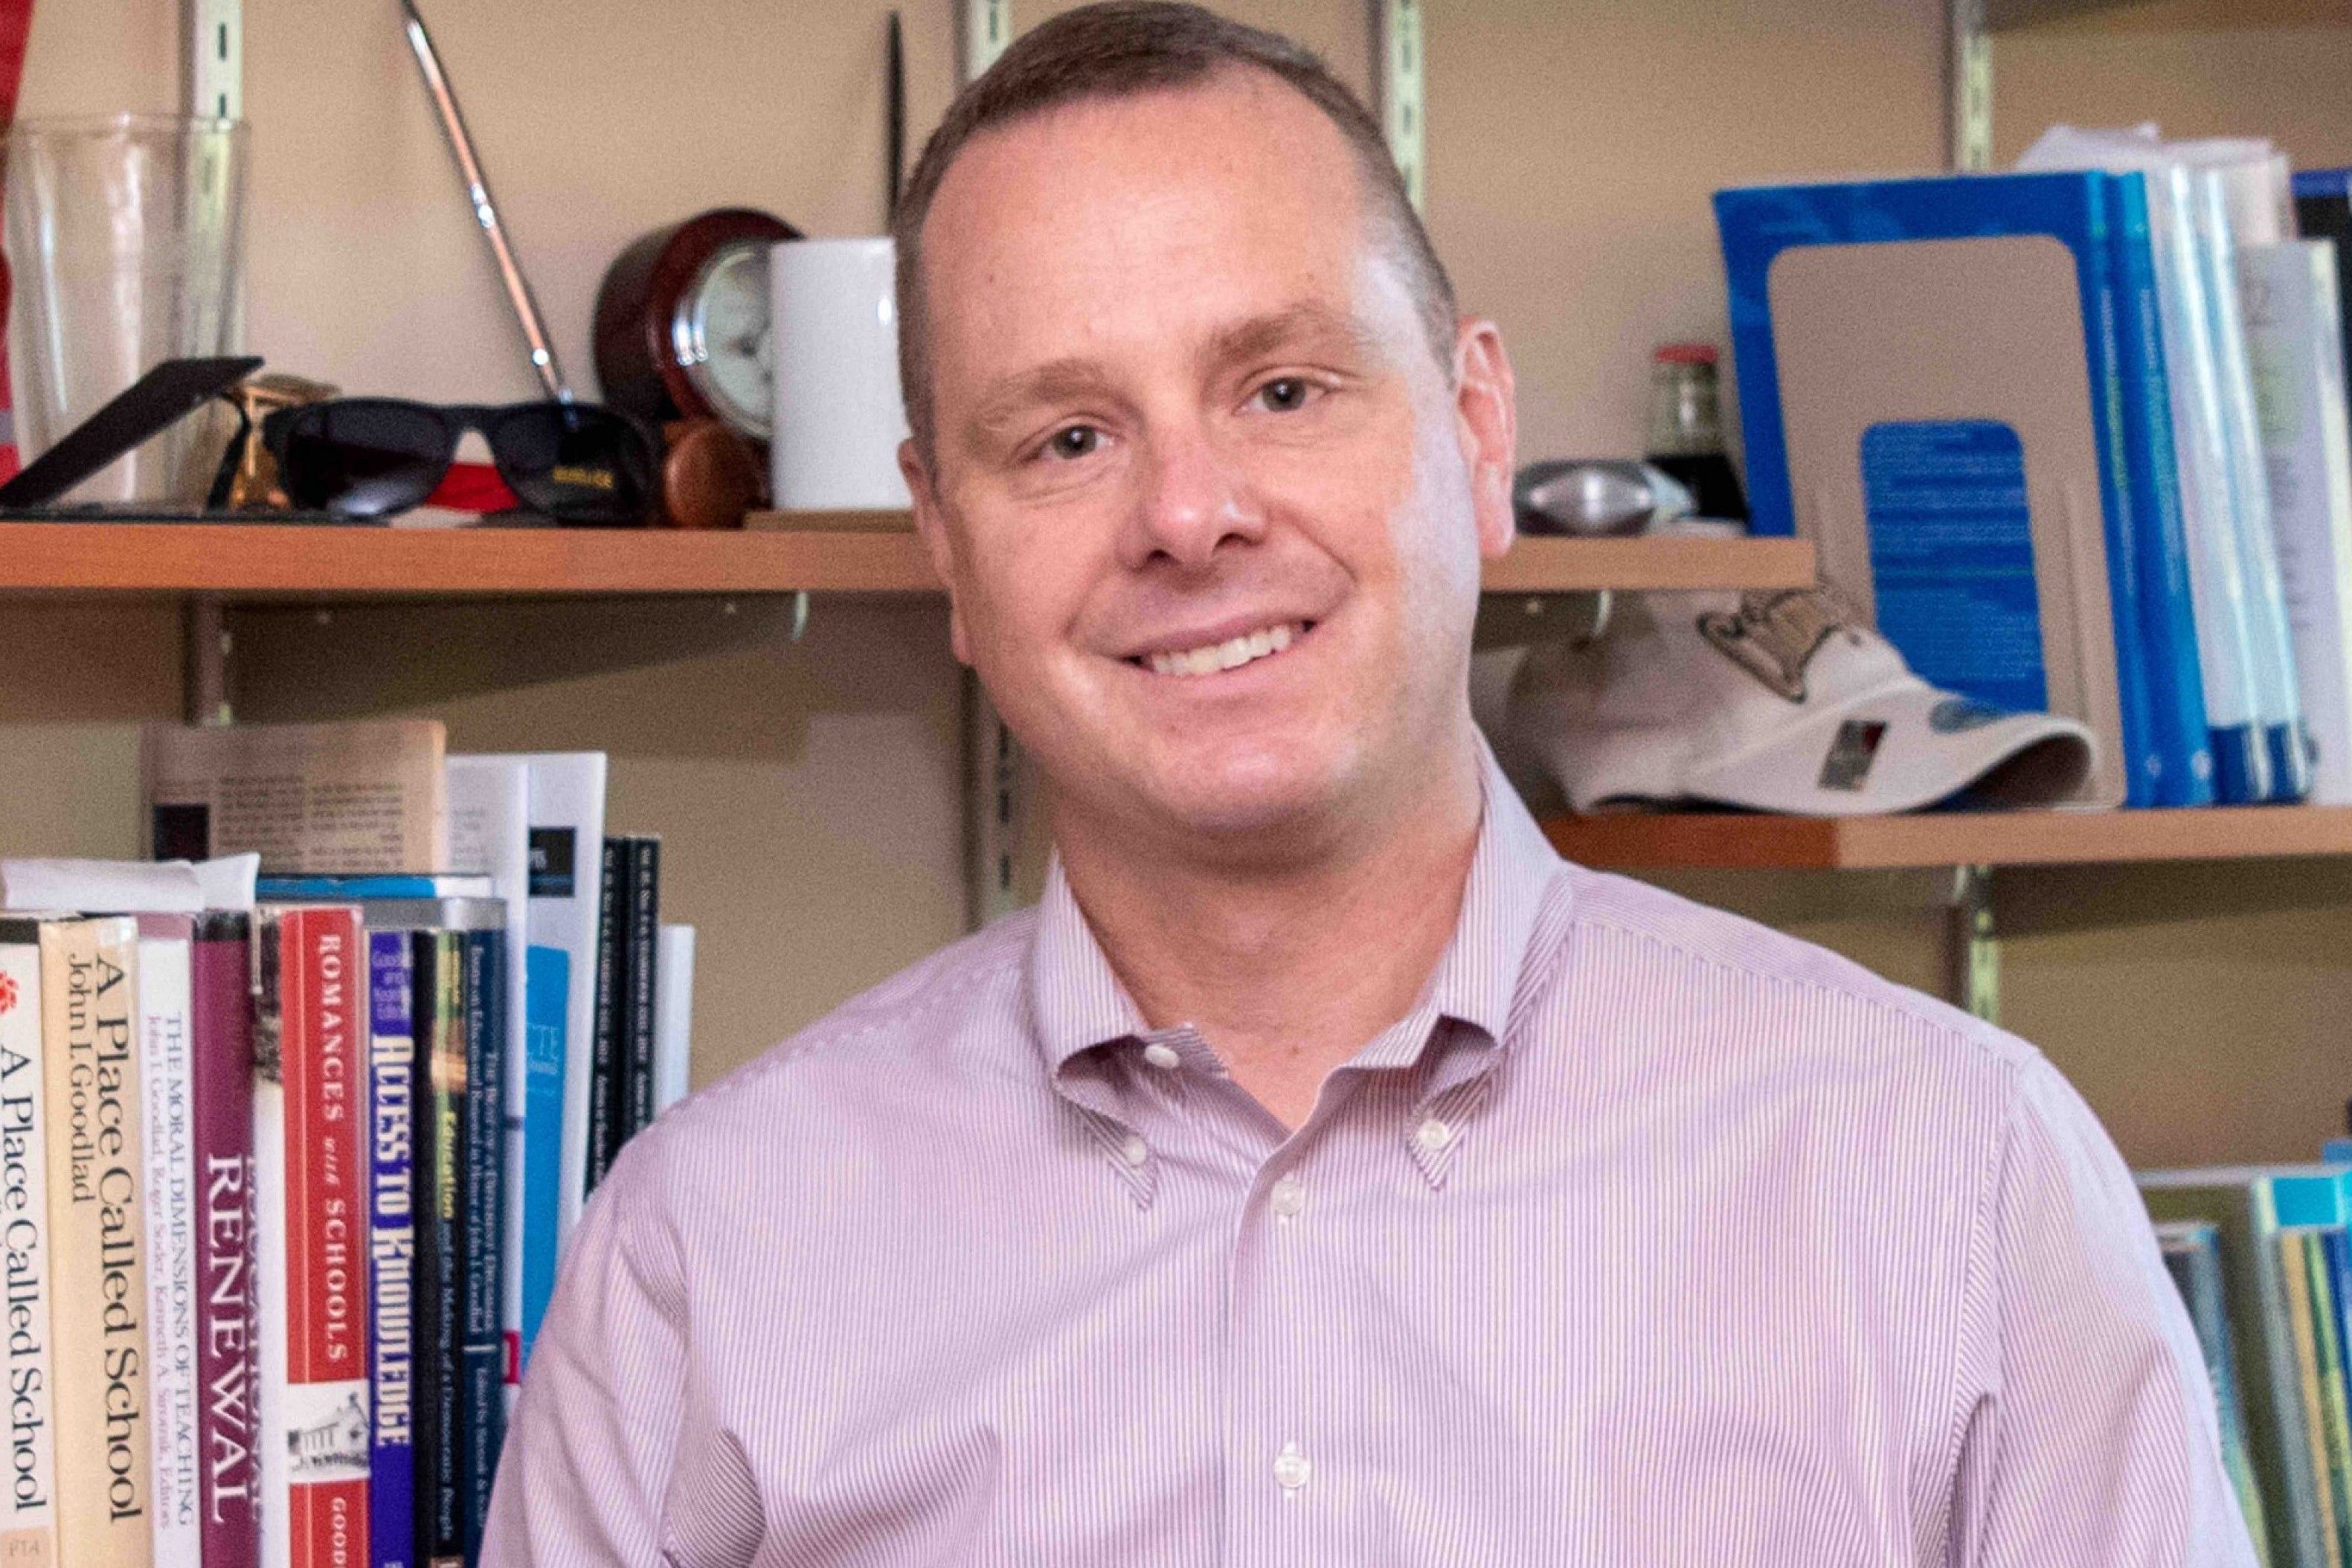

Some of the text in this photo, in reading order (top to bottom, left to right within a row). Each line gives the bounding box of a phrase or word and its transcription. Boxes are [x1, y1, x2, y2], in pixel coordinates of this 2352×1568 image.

[69, 953, 92, 1032] John
[148, 1016, 161, 1055] John
[318, 935, 344, 1122] ROMANCES
[70, 1063, 96, 1203] Goodlad
[372, 1036, 414, 1163] ACCESS
[442, 1111, 456, 1218] Education
[96, 954, 142, 1520] A Place Called School
[150, 1168, 166, 1216] Roger
[376, 1169, 411, 1214] TO
[1, 1046, 47, 1511] A Place Called School
[154, 1286, 170, 1357] Kenneth
[167, 1012, 194, 1526] THE MORAL DIMENSIONS OF TEACHING
[325, 1200, 347, 1360] SCHOOLS
[209, 1154, 248, 1523] RENEWAL
[372, 1226, 414, 1446] KNOWLEDGE
[158, 1467, 173, 1528] Editors
